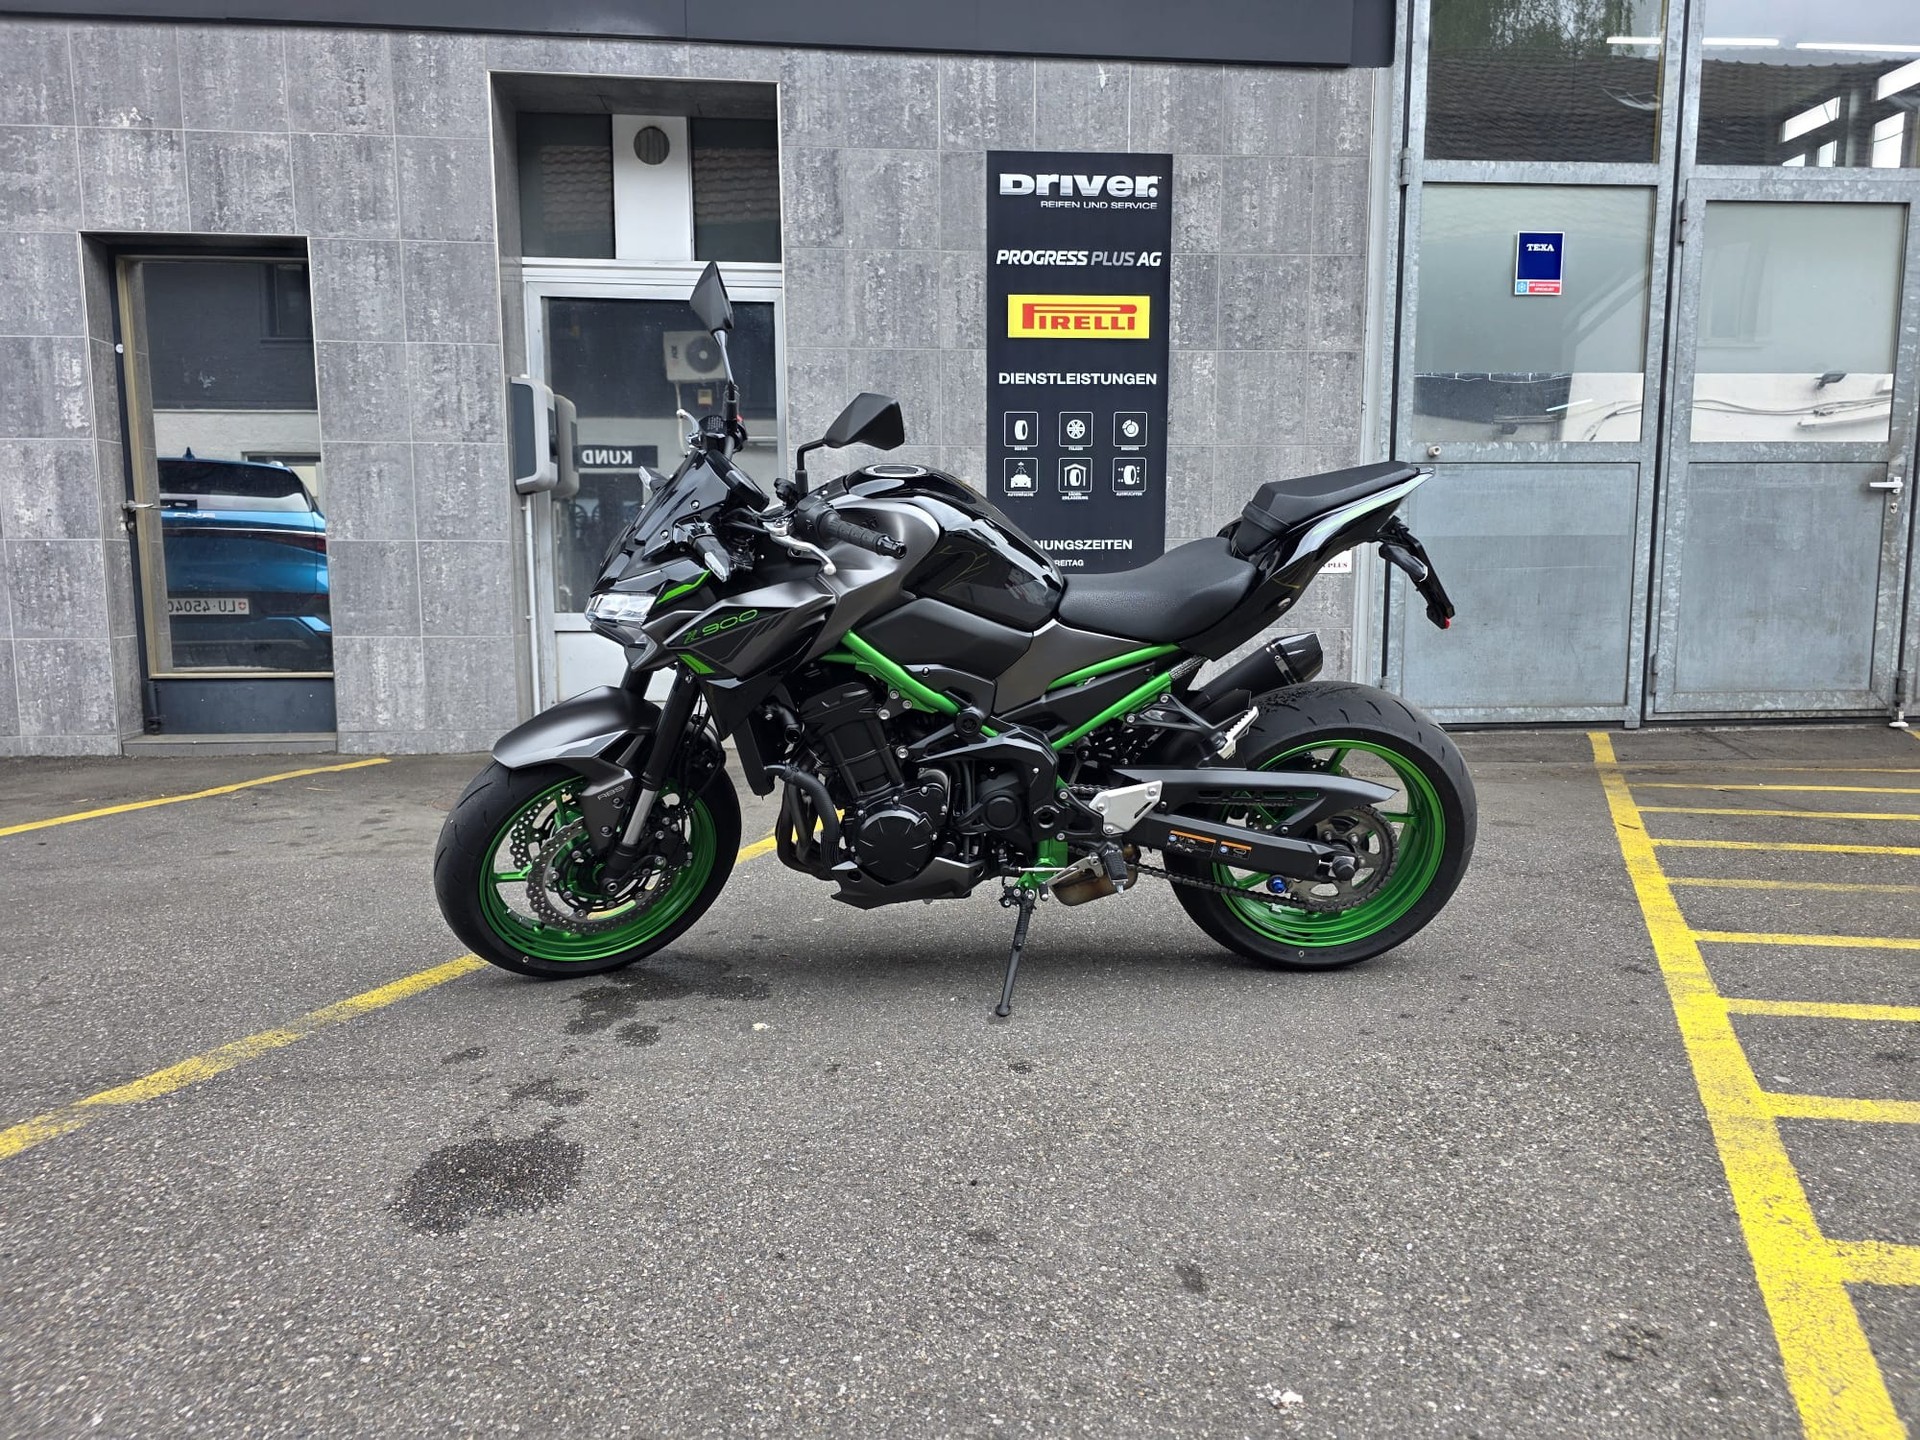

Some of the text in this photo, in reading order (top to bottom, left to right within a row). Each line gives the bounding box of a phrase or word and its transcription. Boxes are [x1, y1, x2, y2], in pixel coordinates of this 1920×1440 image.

[1040, 200, 1158, 210] REIFEN UND SERVICE
[1526, 243, 1555, 252] TEXA
[996, 250, 1163, 267] PROGRESS PLUS AG
[1022, 303, 1138, 331] PIRELLI
[998, 372, 1158, 386] DIENSTLEISTUNGEN
